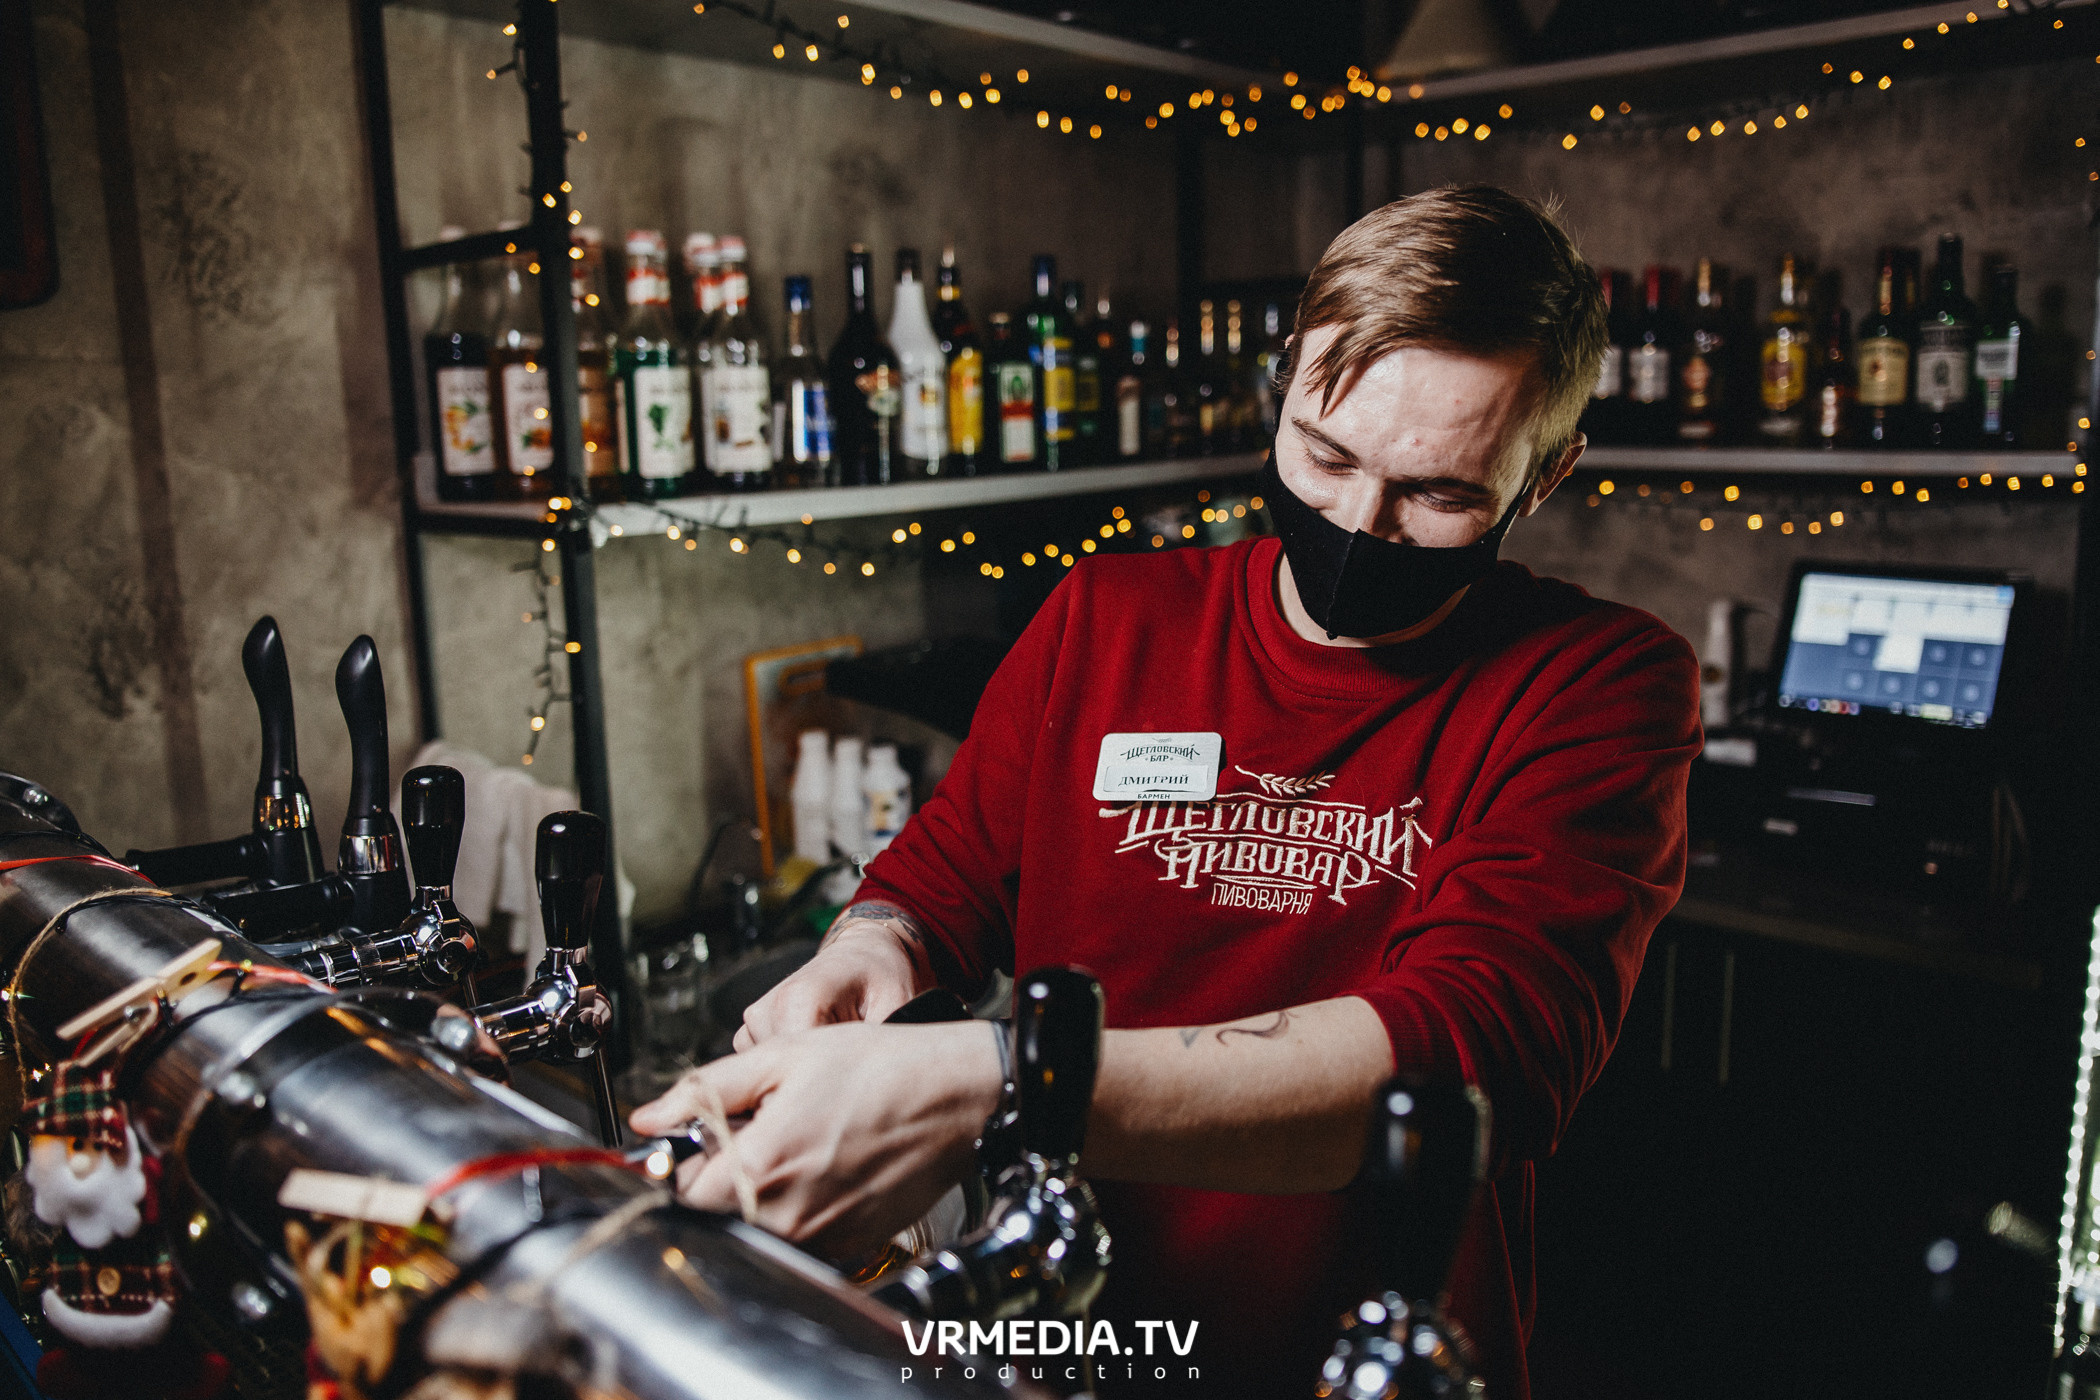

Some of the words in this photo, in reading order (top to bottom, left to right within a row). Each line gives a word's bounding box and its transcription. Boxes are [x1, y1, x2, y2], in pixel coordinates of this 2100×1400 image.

[1120, 744, 1200, 761] ЩЕГЛОВСКИЙ
[1117, 774, 1190, 787] ДМИТРИЙ
[1099, 797, 1432, 878] ЩЕГЛОВСКИЙ
[1154, 837, 1379, 906] ПИВОВАР
[1210, 882, 1314, 915] ПИВОВАРНЯ
